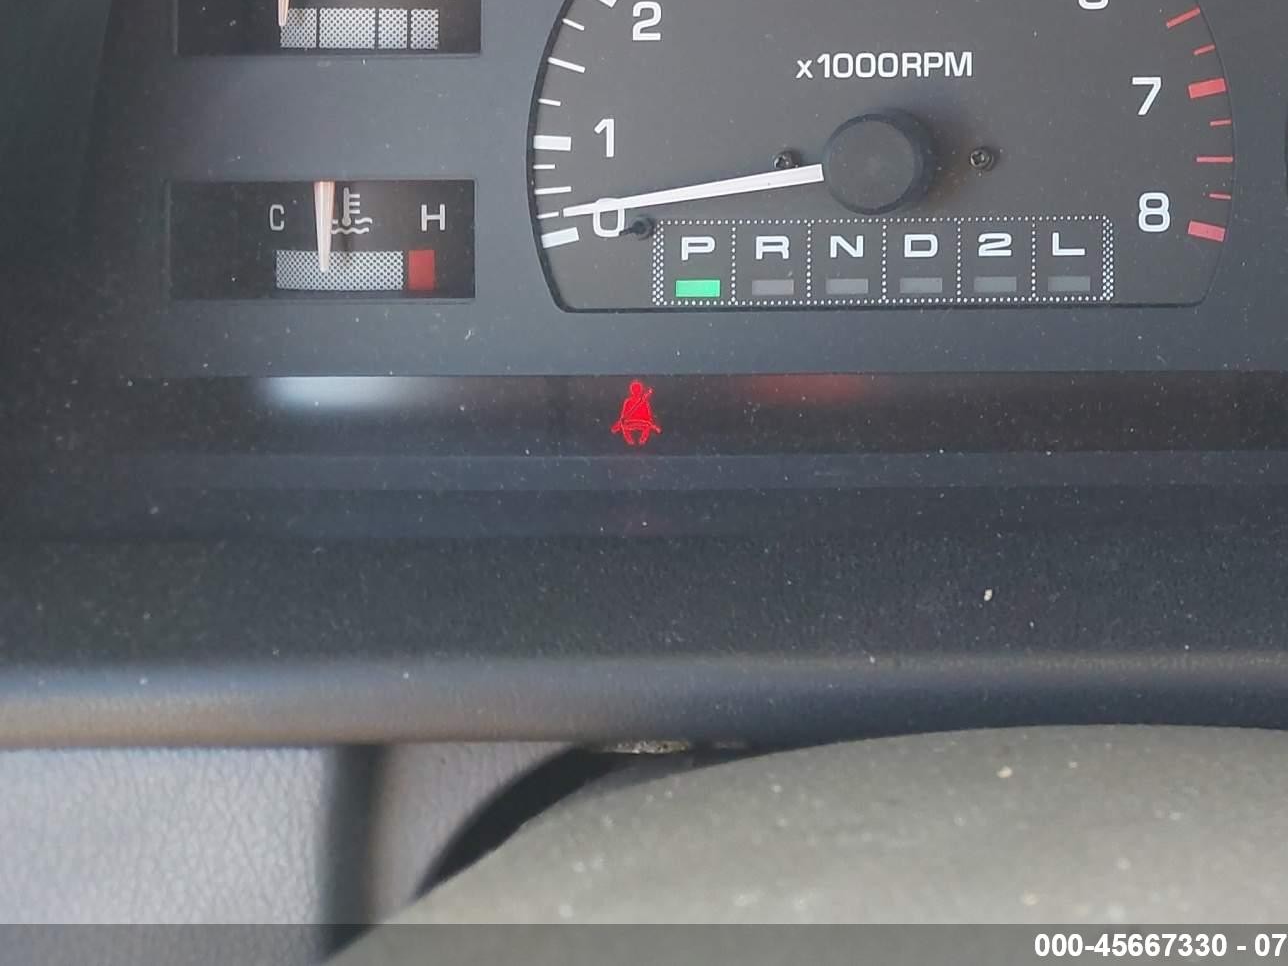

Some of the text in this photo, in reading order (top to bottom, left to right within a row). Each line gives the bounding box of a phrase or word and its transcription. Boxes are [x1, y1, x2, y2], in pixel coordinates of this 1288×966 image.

[632, 1, 662, 41] 2
[1132, 76, 1162, 116] 7
[594, 118, 615, 158] 1
[269, 203, 446, 232] C H
[1138, 192, 1171, 232] 8
[681, 232, 1086, 261] P R N D 2 L
